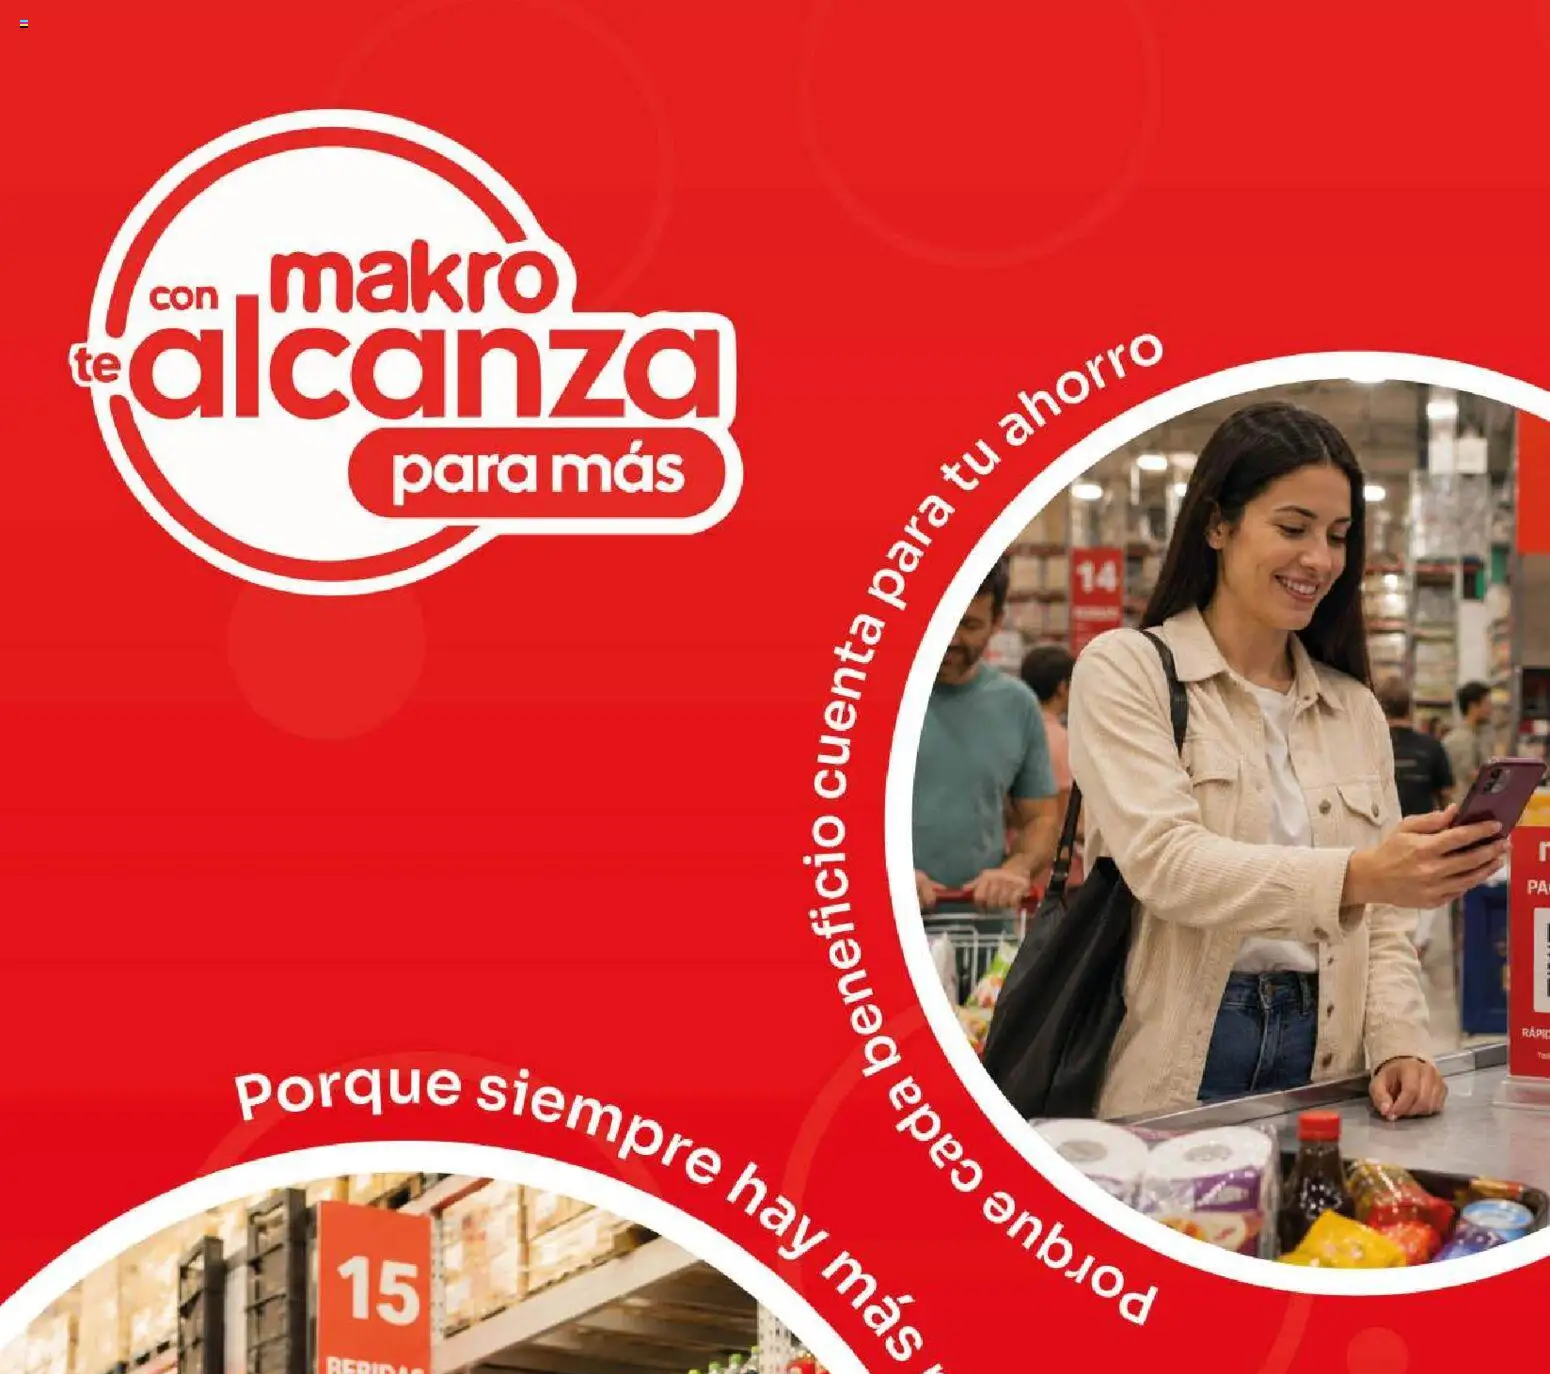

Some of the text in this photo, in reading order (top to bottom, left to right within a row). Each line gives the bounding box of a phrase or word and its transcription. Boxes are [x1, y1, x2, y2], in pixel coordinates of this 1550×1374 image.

[150, 238, 559, 314] con makro
[74, 294, 720, 420] te alcanza
[393, 440, 686, 507] para más
[1075, 559, 1117, 594] 14
[803, 333, 1164, 1326] Porque cada beneficio cuenta para tu ahorro
[235, 1069, 462, 1121] Porque
[476, 1068, 722, 1185] siempre
[727, 1161, 830, 1260] hay
[822, 1250, 924, 1362] más
[337, 1255, 420, 1327] 15
